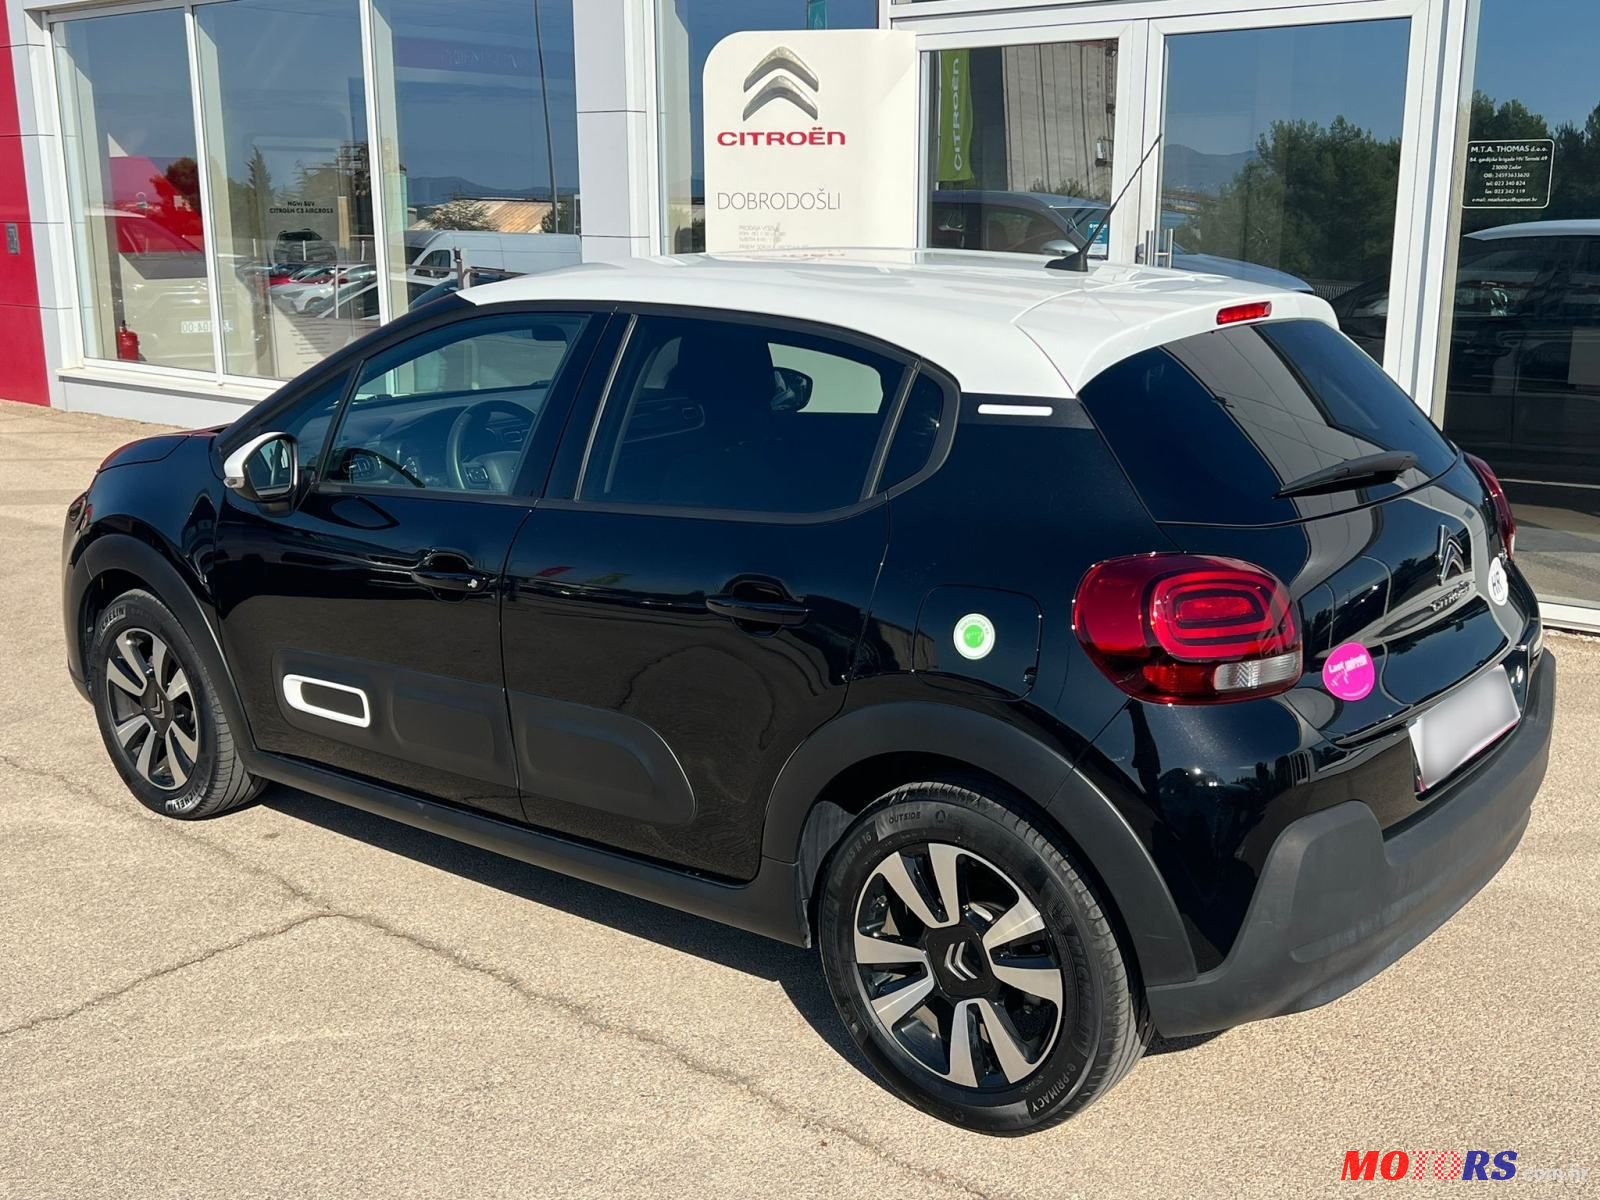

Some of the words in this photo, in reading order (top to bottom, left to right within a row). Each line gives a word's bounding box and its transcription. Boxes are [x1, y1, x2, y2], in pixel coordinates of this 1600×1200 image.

[717, 127, 846, 146] CITROËN
[717, 188, 841, 210] DOBRODOŠLI
[888, 811, 921, 825] OUTSIDE
